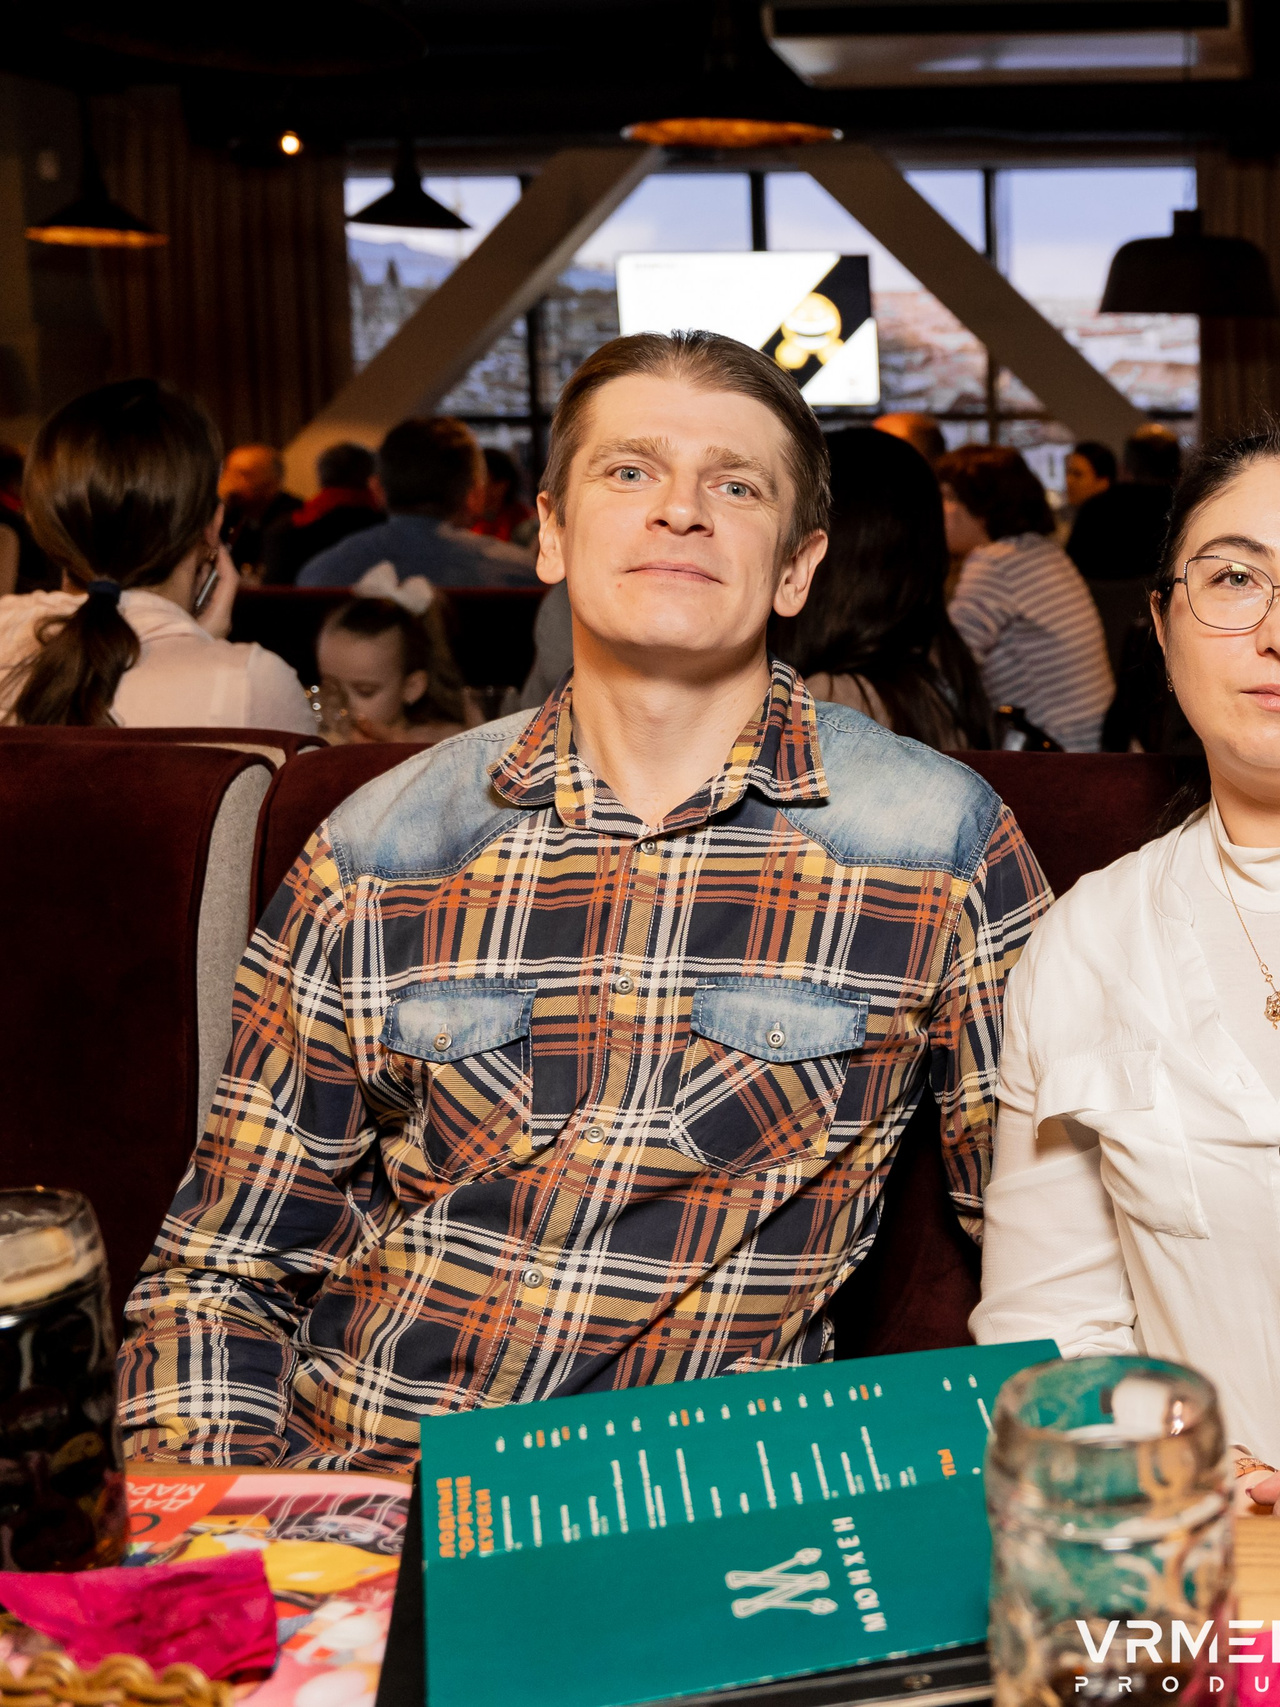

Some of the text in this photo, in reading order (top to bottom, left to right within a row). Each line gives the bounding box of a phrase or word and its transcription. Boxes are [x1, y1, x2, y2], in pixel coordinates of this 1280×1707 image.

[938, 1449, 957, 1480] ПЫ
[455, 1475, 476, 1559] ОРЯЧИЕ
[832, 1516, 887, 1632] МЮНХЕН
